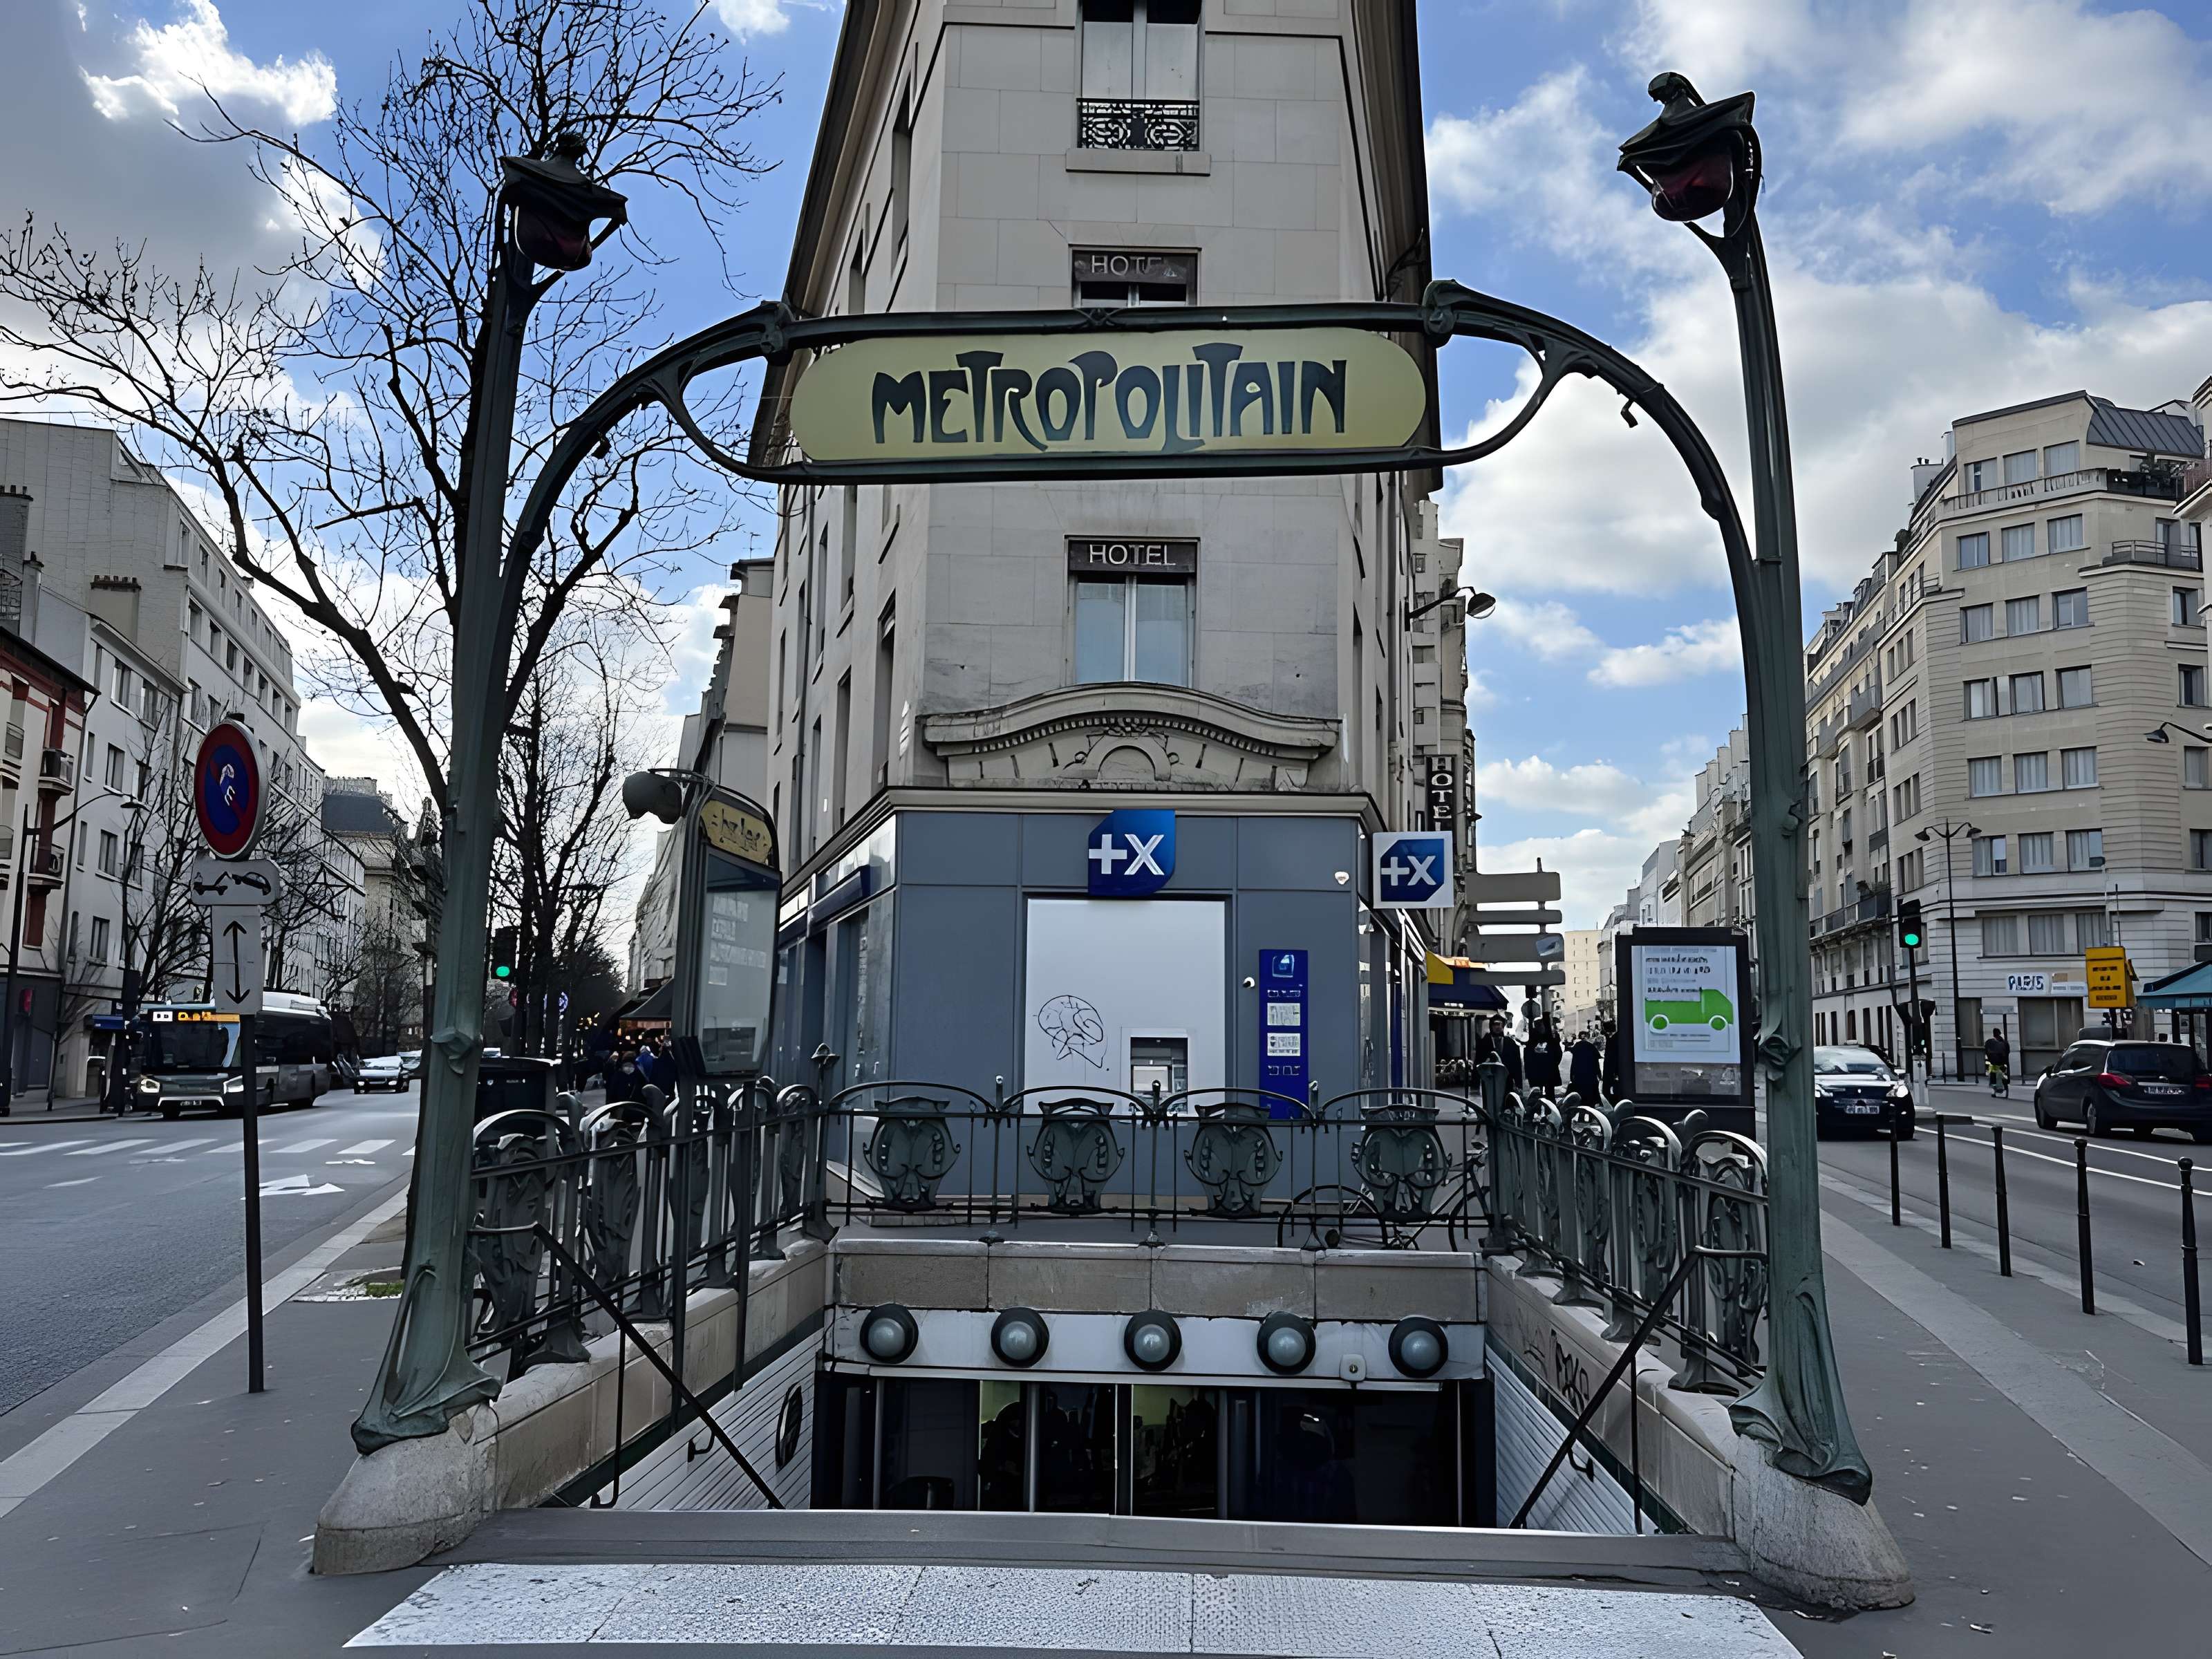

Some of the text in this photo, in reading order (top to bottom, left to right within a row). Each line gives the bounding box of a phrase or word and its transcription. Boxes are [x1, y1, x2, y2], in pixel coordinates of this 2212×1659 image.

[1091, 254, 1163, 276] HOTE
[872, 342, 1347, 451] METROPOLITAIN
[1089, 544, 1177, 565] HOTEL
